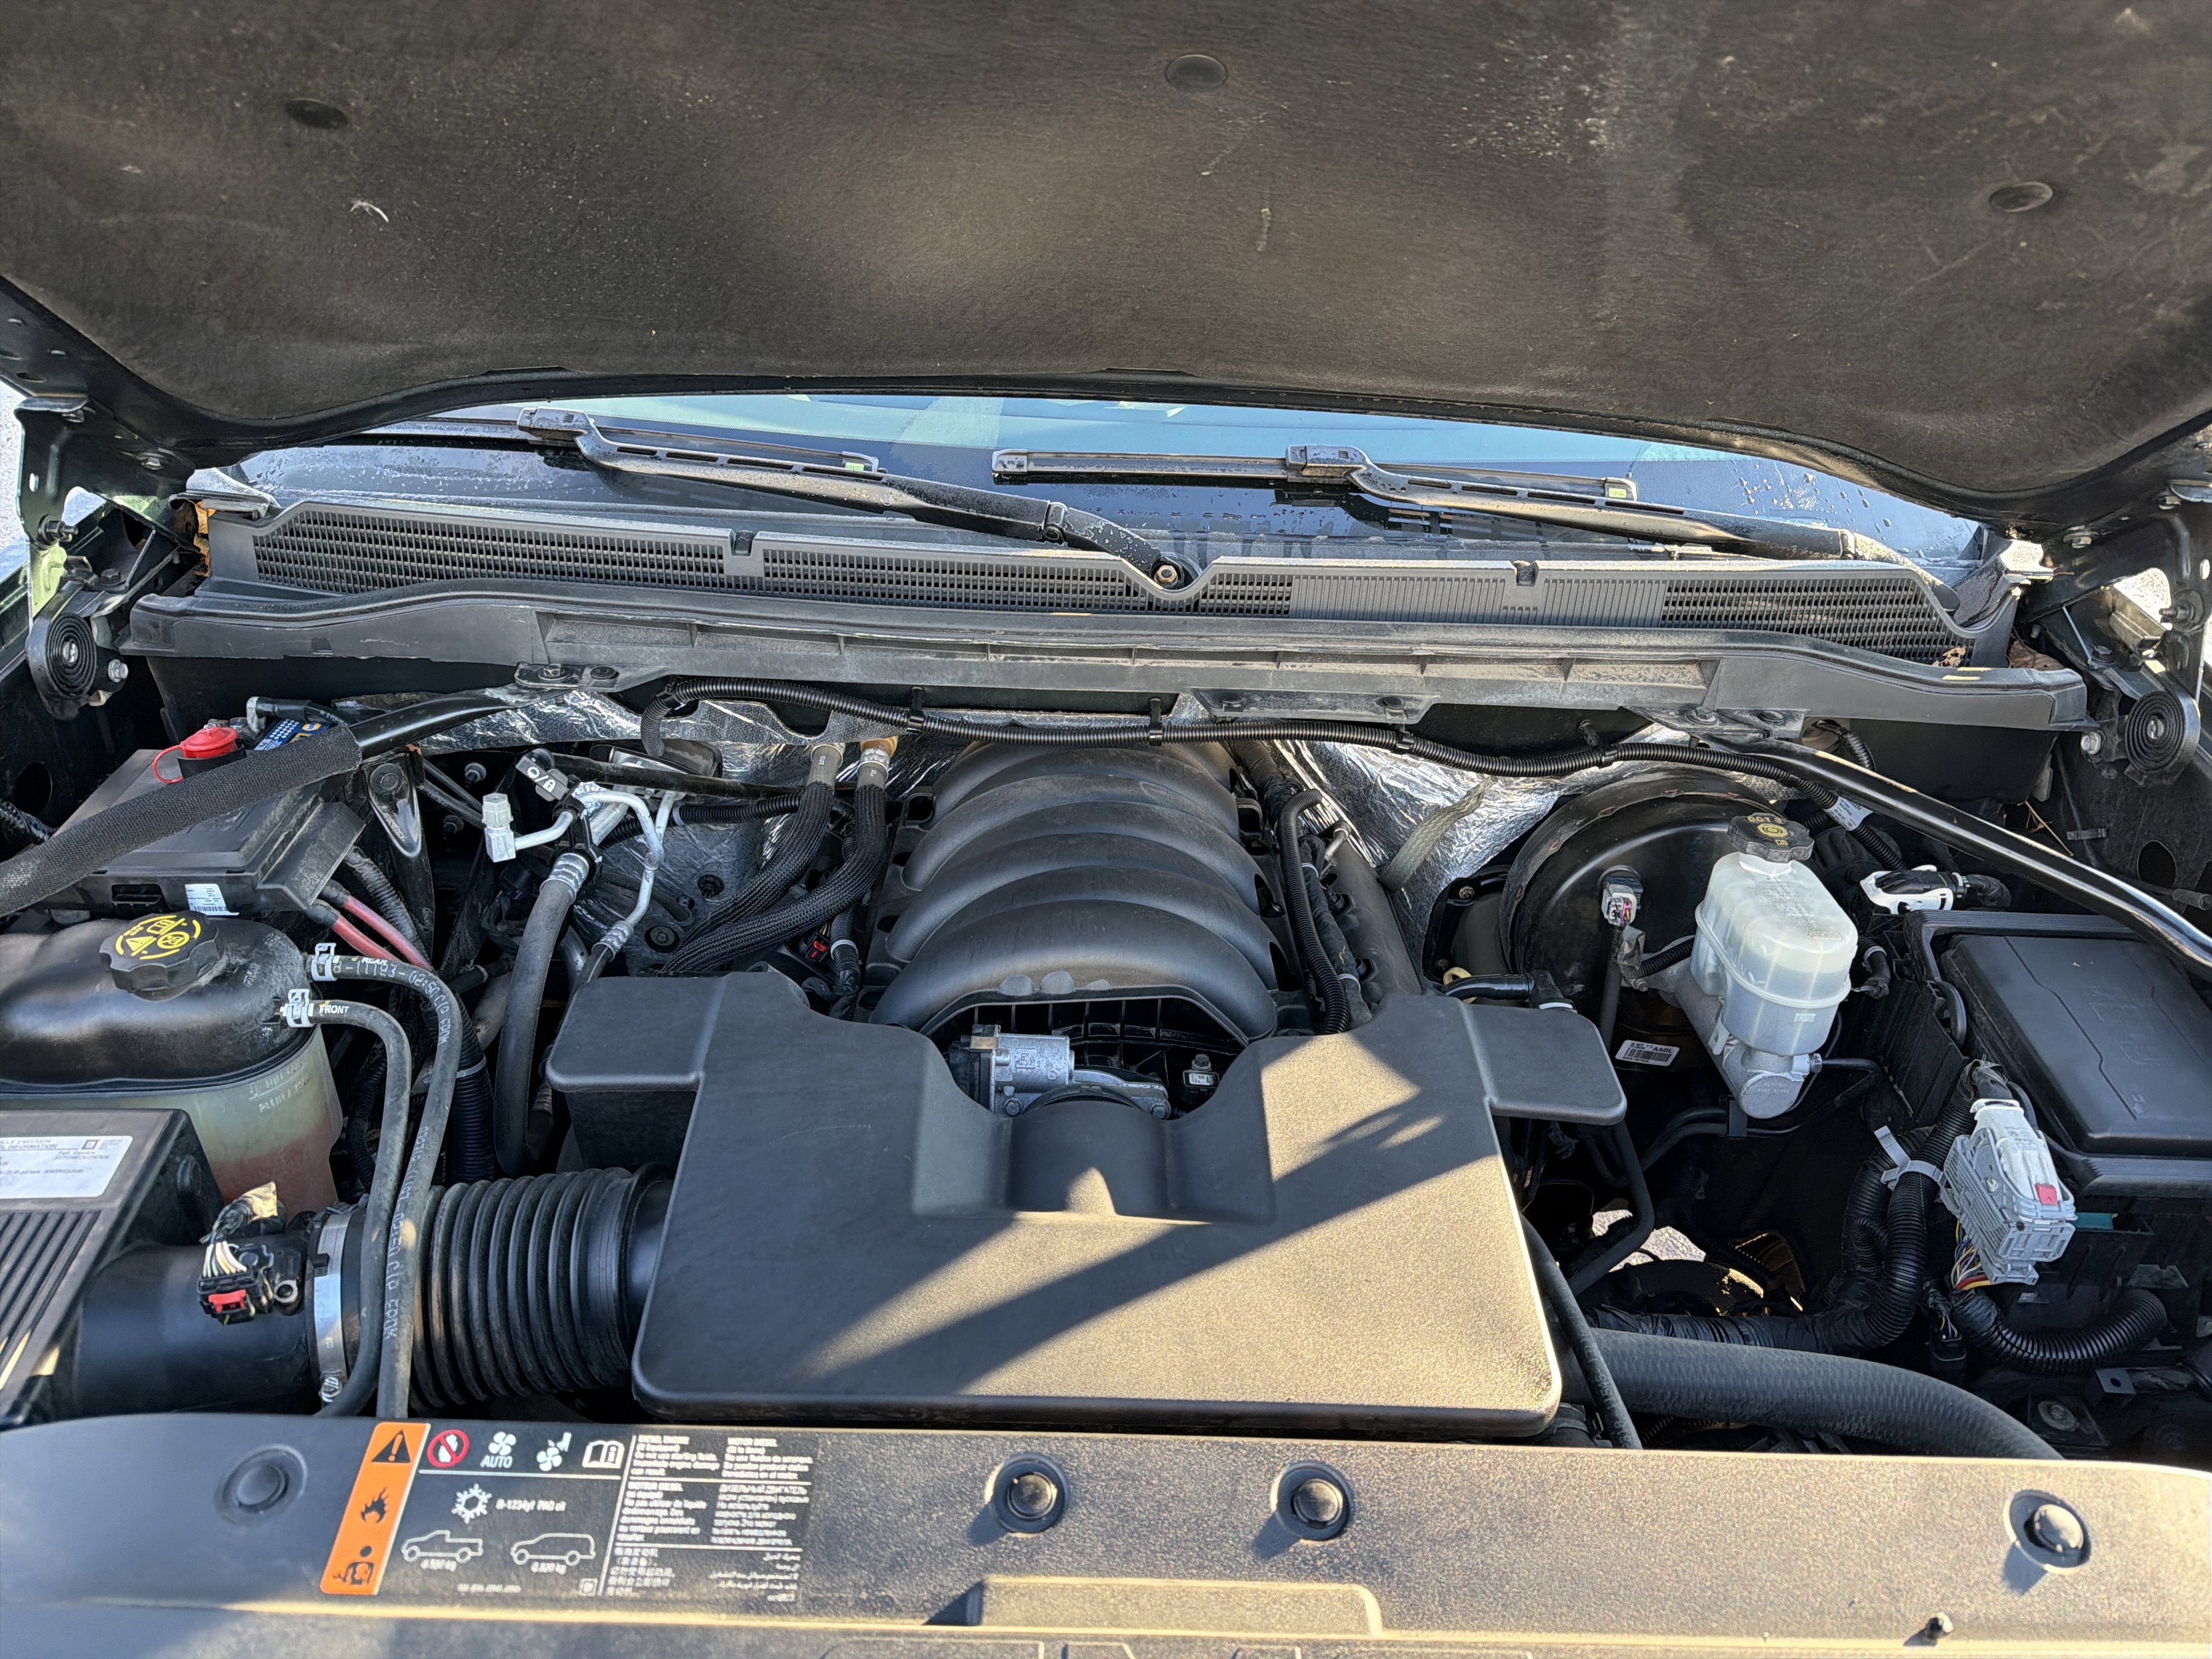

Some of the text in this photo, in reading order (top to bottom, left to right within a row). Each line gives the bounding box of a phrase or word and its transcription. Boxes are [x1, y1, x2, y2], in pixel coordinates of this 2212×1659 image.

[361, 957, 388, 966] REAR
[319, 1005, 349, 1014] FRONT
[480, 1455, 513, 1469] AUTO
[496, 1499, 535, 1513] R-1234yf
[537, 1500, 555, 1511] PAG
